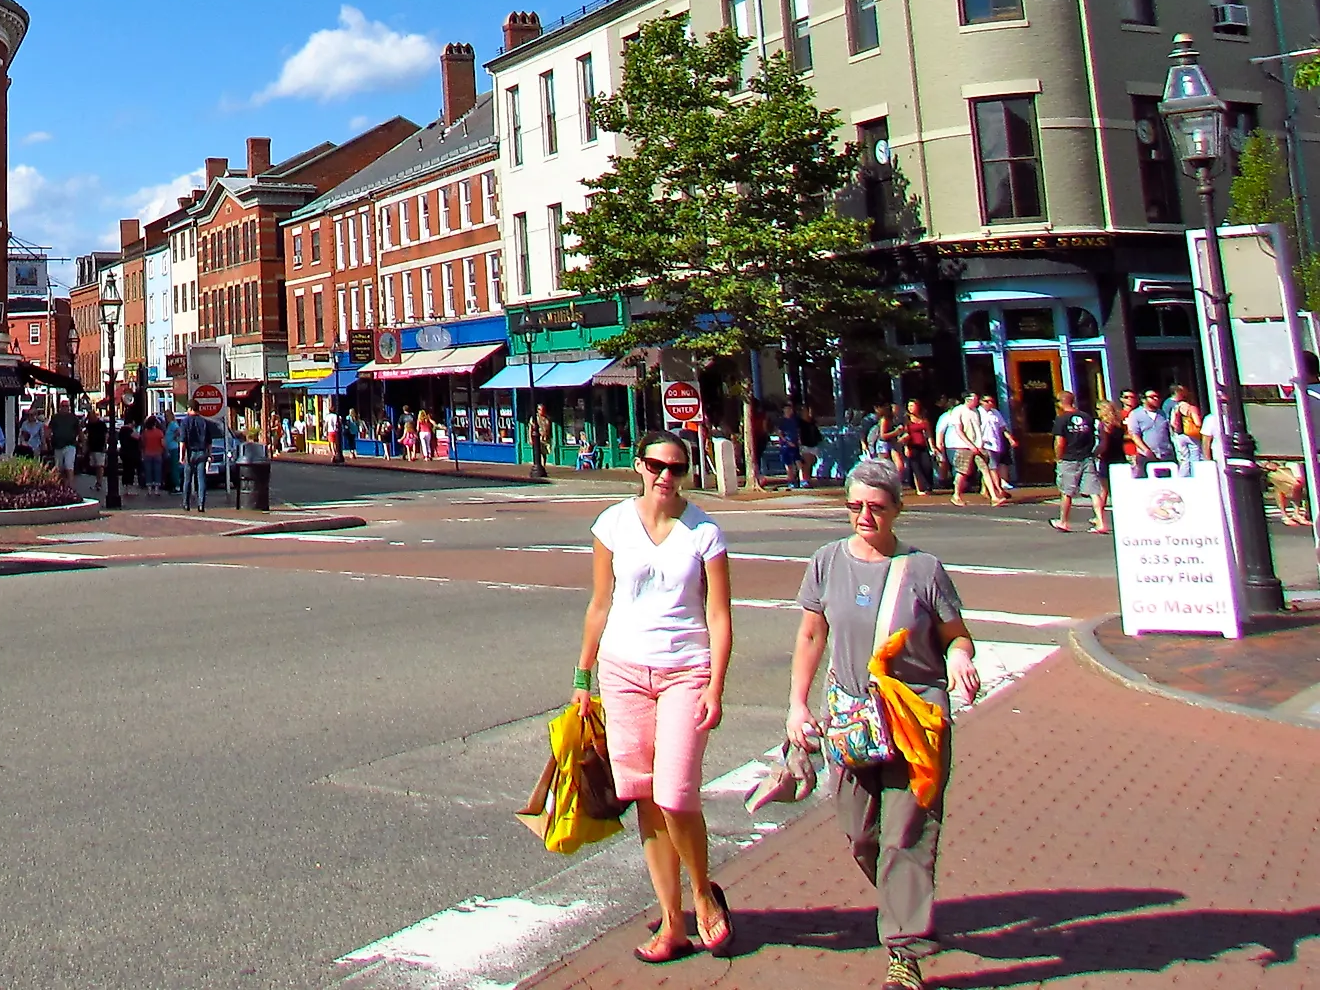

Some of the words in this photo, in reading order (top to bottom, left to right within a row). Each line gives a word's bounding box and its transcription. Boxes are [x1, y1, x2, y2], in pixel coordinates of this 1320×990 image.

[1055, 237, 1107, 247] SONS
[1122, 536, 1161, 547] Game
[1165, 535, 1220, 548] Tonight
[1140, 554, 1170, 564] 6:35
[1174, 556, 1205, 566] p.m.
[1136, 572, 1174, 584] Leary
[1178, 571, 1214, 583] Field
[1132, 600, 1157, 613] Go
[1164, 600, 1227, 614] Mavs!!
